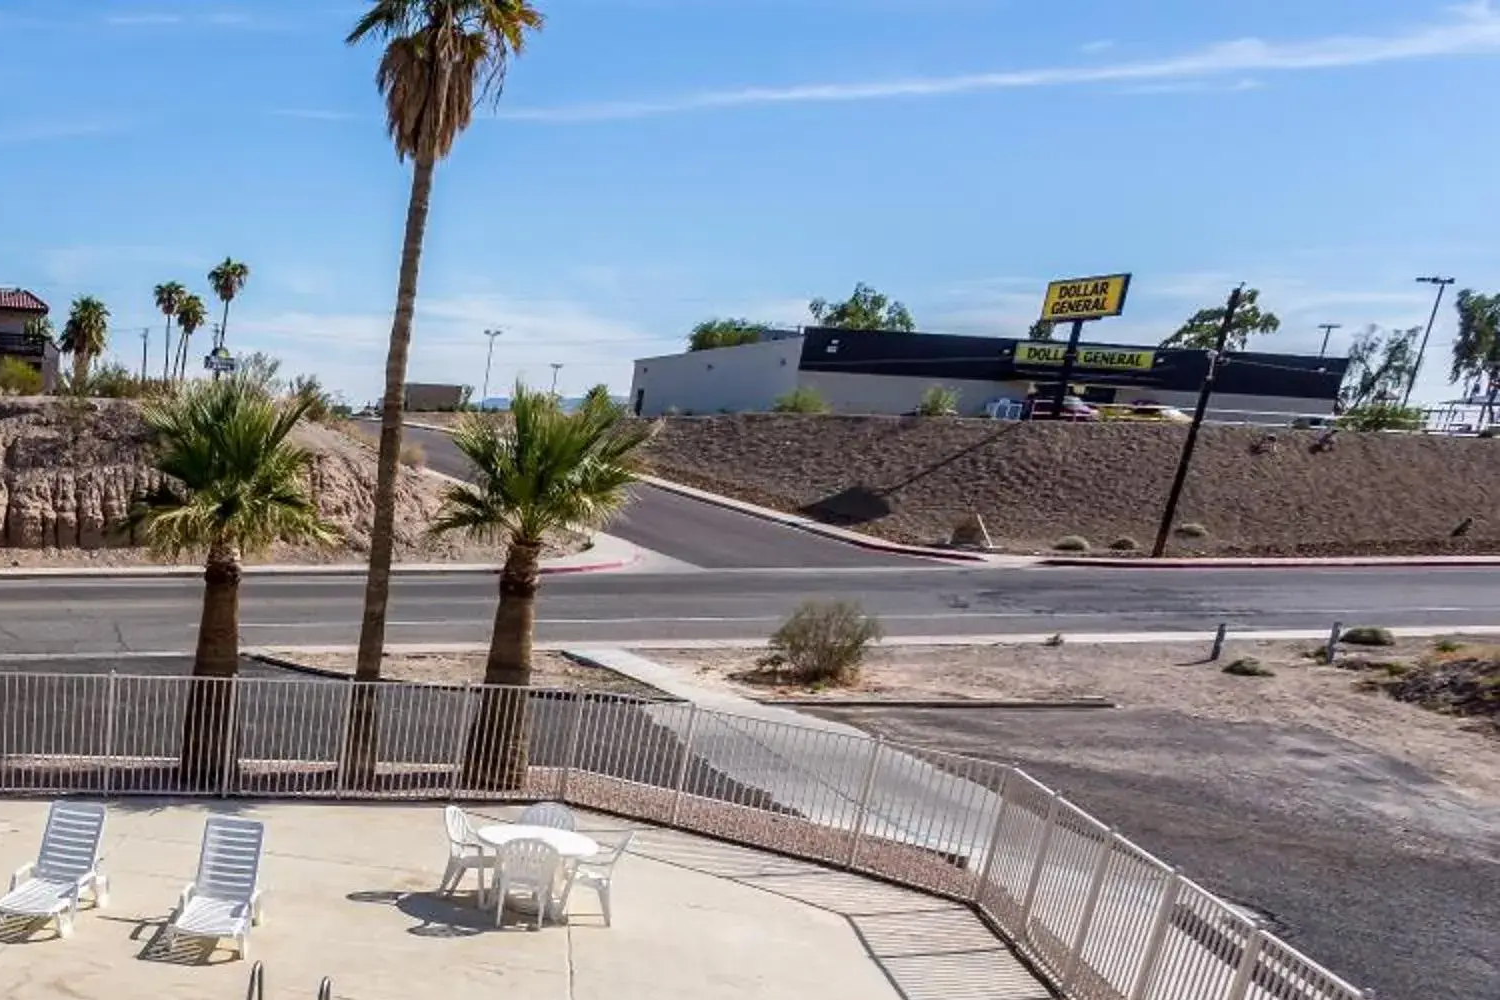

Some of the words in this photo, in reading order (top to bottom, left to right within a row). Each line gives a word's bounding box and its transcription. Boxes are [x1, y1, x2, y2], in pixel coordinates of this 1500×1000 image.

[1058, 281, 1109, 299] DOLLAR
[1051, 297, 1107, 314] GENERAL
[1083, 351, 1144, 367] GENERAL
